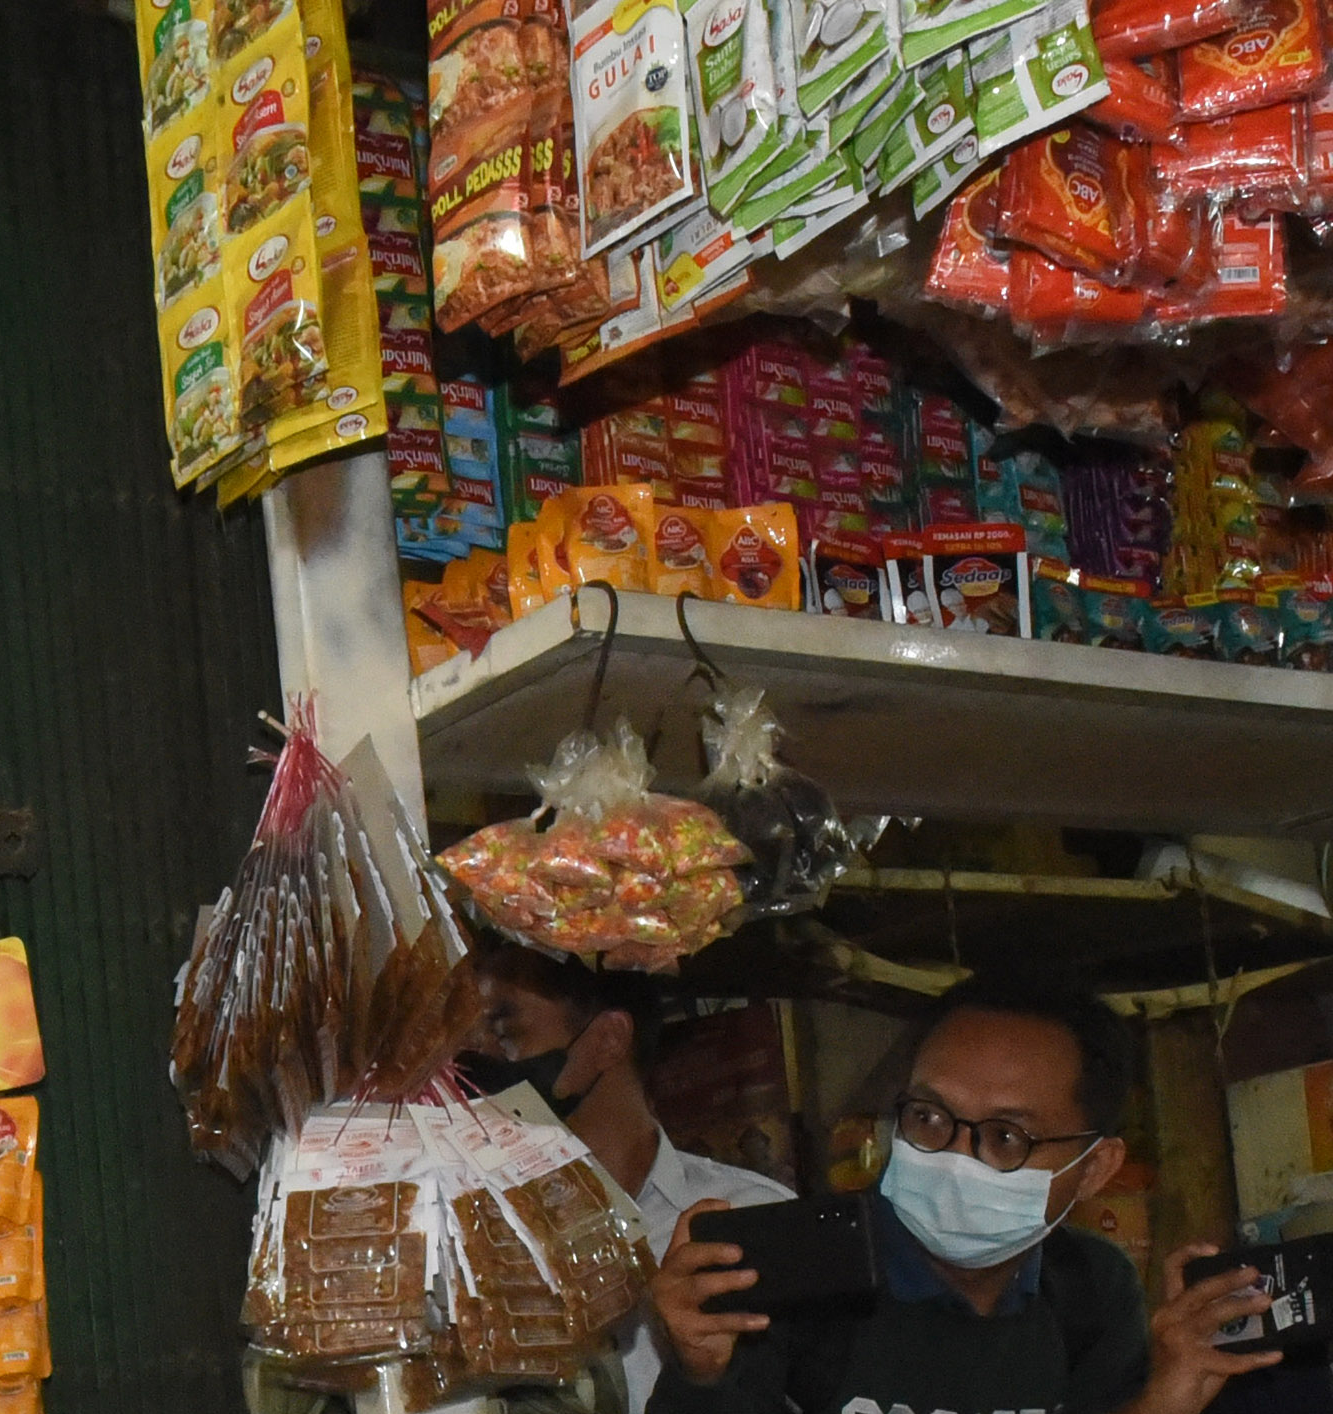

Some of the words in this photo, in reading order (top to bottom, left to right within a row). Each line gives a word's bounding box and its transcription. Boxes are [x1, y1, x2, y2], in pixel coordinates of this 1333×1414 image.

[429, 1, 460, 40] POLL
[710, 7, 744, 36] Sasa
[593, 45, 623, 74] Bumbu
[623, 26, 648, 53] Instan
[1232, 33, 1272, 58] ABC
[589, 34, 656, 100] GULAI
[648, 70, 667, 83] TOP
[431, 185, 464, 224] POLL
[466, 145, 523, 198] PEDASSS
[1071, 183, 1102, 201] ABC
[974, 531, 986, 539] RP
[940, 566, 1013, 586] Sedaap
